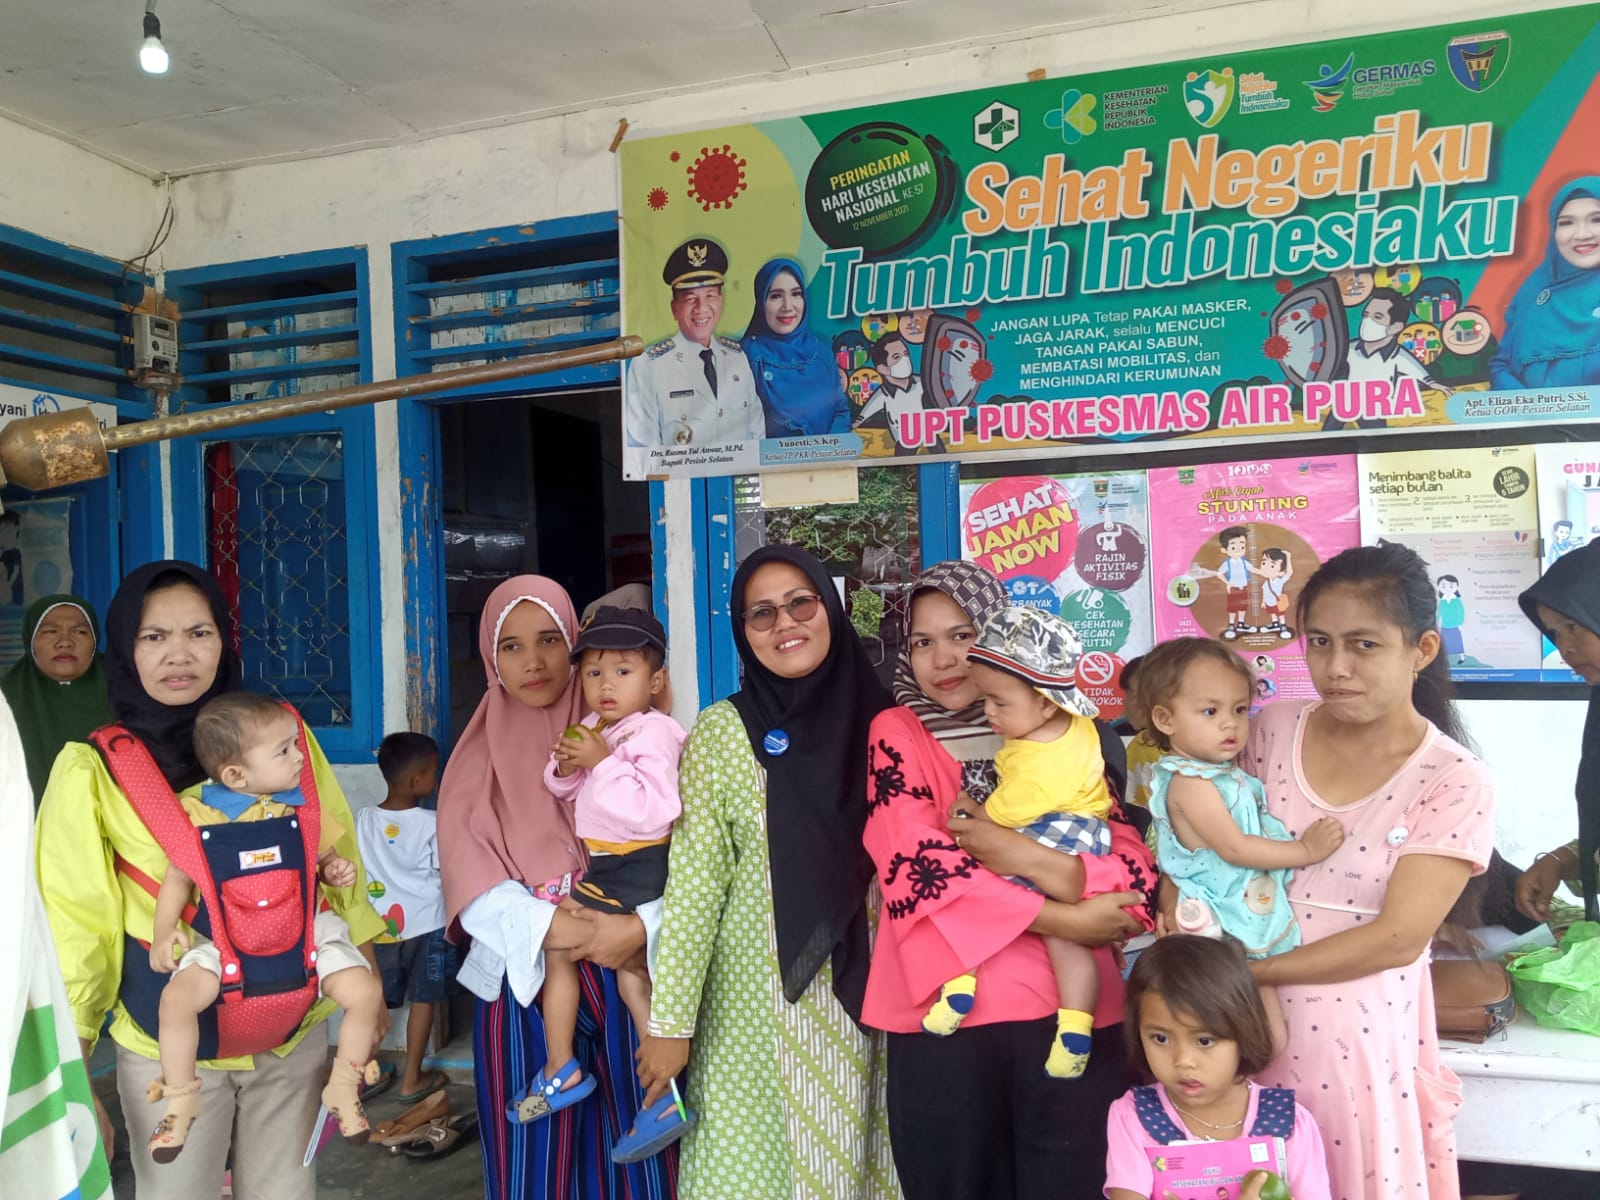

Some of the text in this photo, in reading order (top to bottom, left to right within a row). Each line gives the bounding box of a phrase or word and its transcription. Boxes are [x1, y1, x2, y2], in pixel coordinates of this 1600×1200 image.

[1353, 60, 1436, 83] GERMAS
[1103, 84, 1168, 101] KEMENTERIAN
[1103, 97, 1156, 111] KESEHATAN
[1103, 108, 1147, 121] REPUBLIK
[1103, 116, 1155, 131] INDONESIA
[829, 149, 911, 191] PERINGATAN
[962, 109, 1494, 236] Sehat Negeriku
[821, 161, 931, 212] HARI KESEHATAN
[834, 183, 924, 224] NASIONAL KE-57
[852, 204, 910, 231] 12 NOVEMBER 2021
[824, 182, 1518, 319] Tumbuh Indonesiaku
[990, 298, 1251, 333] JANGAN LUPA Tetap PAKAI MASKER,
[1015, 316, 1225, 345] JAGA JARAK, selalu MENCUCI
[1035, 335, 1203, 359] TANGAN PAKAI SABUN,
[1020, 350, 1221, 375] MEMBATASI MOBILITAS, dan
[1019, 364, 1222, 390] MENGHINDARI KERUMUNAN
[1464, 399, 1485, 409] Apt.
[1488, 396, 1512, 407] Eliza
[1515, 395, 1535, 405] Eka
[1464, 402, 1591, 418] Ketua GOW Pesisir Selatan
[898, 376, 1425, 448] UPT PUSKESMAS AIR PURA
[778, 437, 812, 449] Yunesti,
[708, 455, 734, 464] Selatan
[794, 450, 811, 460] PKK
[1368, 467, 1472, 483] Menimbang balita
[1369, 481, 1443, 496] setiap bulan
[967, 483, 1054, 534] SEHAT
[1198, 495, 1309, 516] STUNTING
[1208, 511, 1297, 524] PADA ANAK
[968, 502, 1074, 559] JAMAN
[991, 530, 1060, 574] NOW
[1094, 553, 1126, 563] RAJIN
[1083, 562, 1138, 573] AKTIVITAS
[1095, 571, 1126, 581] FISIK
[1011, 599, 1052, 608] RBANYAK
[1085, 610, 1105, 620] CEK
[1078, 629, 1115, 638] SECARA
[1081, 638, 1112, 647] RUTIN
[1083, 687, 1114, 697] TIDAK
[1090, 696, 1124, 706] ROKOK
[1344, 871, 1362, 881] LOVE
